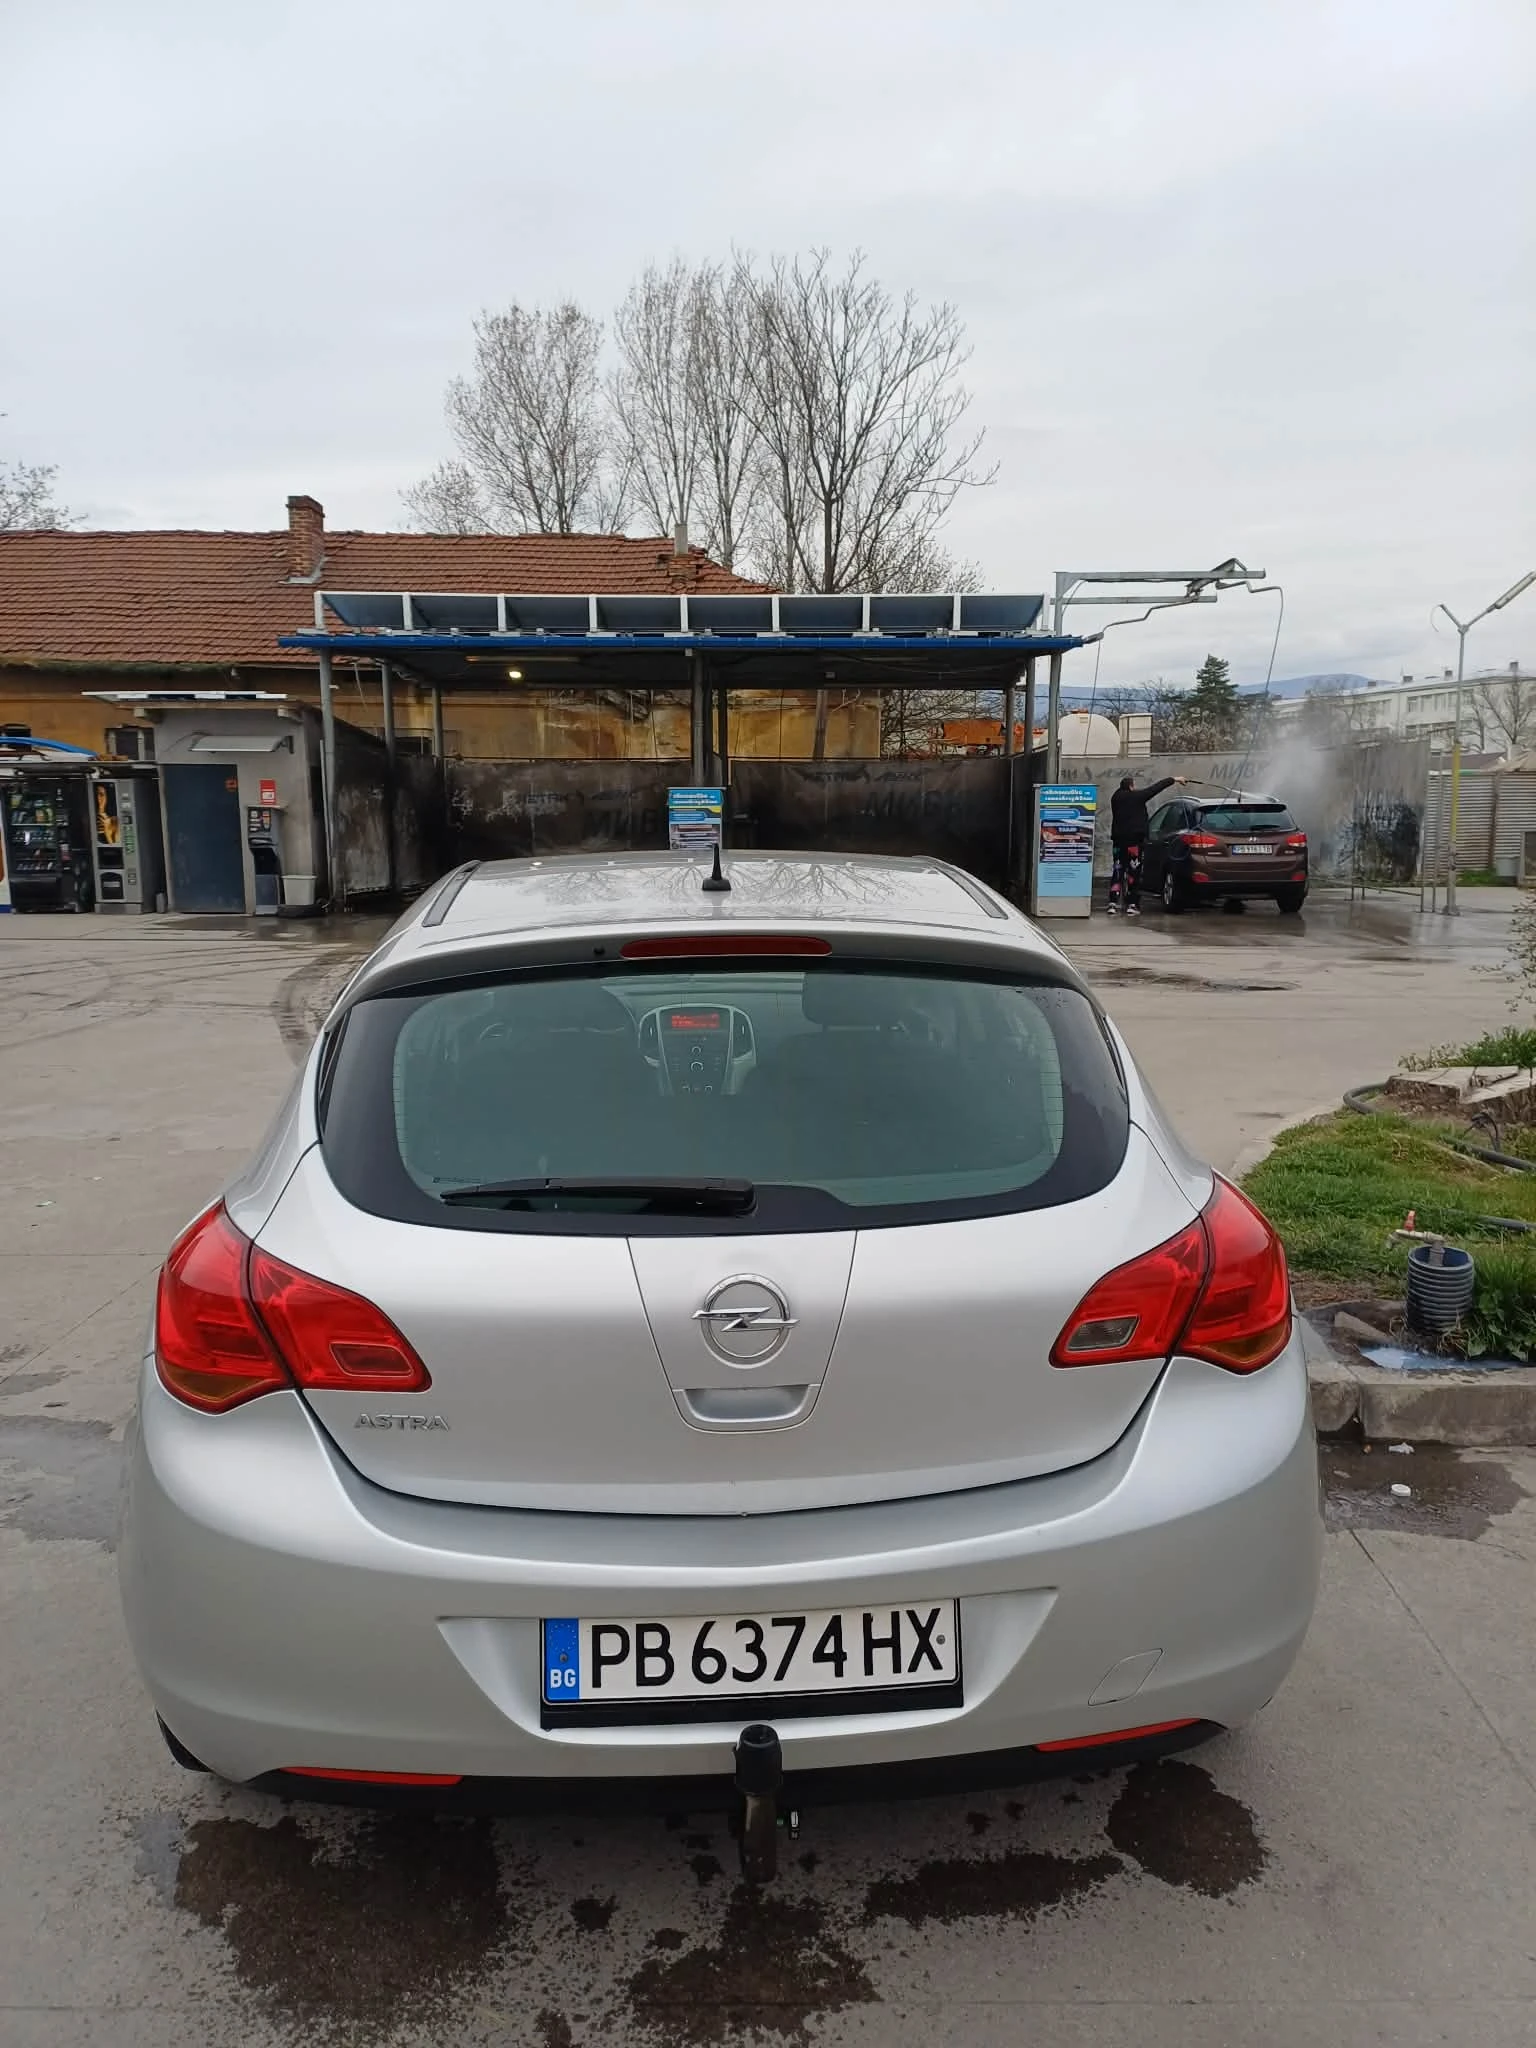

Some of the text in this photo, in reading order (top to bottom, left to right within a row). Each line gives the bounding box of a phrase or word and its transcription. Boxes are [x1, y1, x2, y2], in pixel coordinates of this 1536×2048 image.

[354, 1413, 450, 1432] ASTRA
[591, 1607, 943, 1689] PB 6374 HX
[550, 1668, 576, 1689] BG
